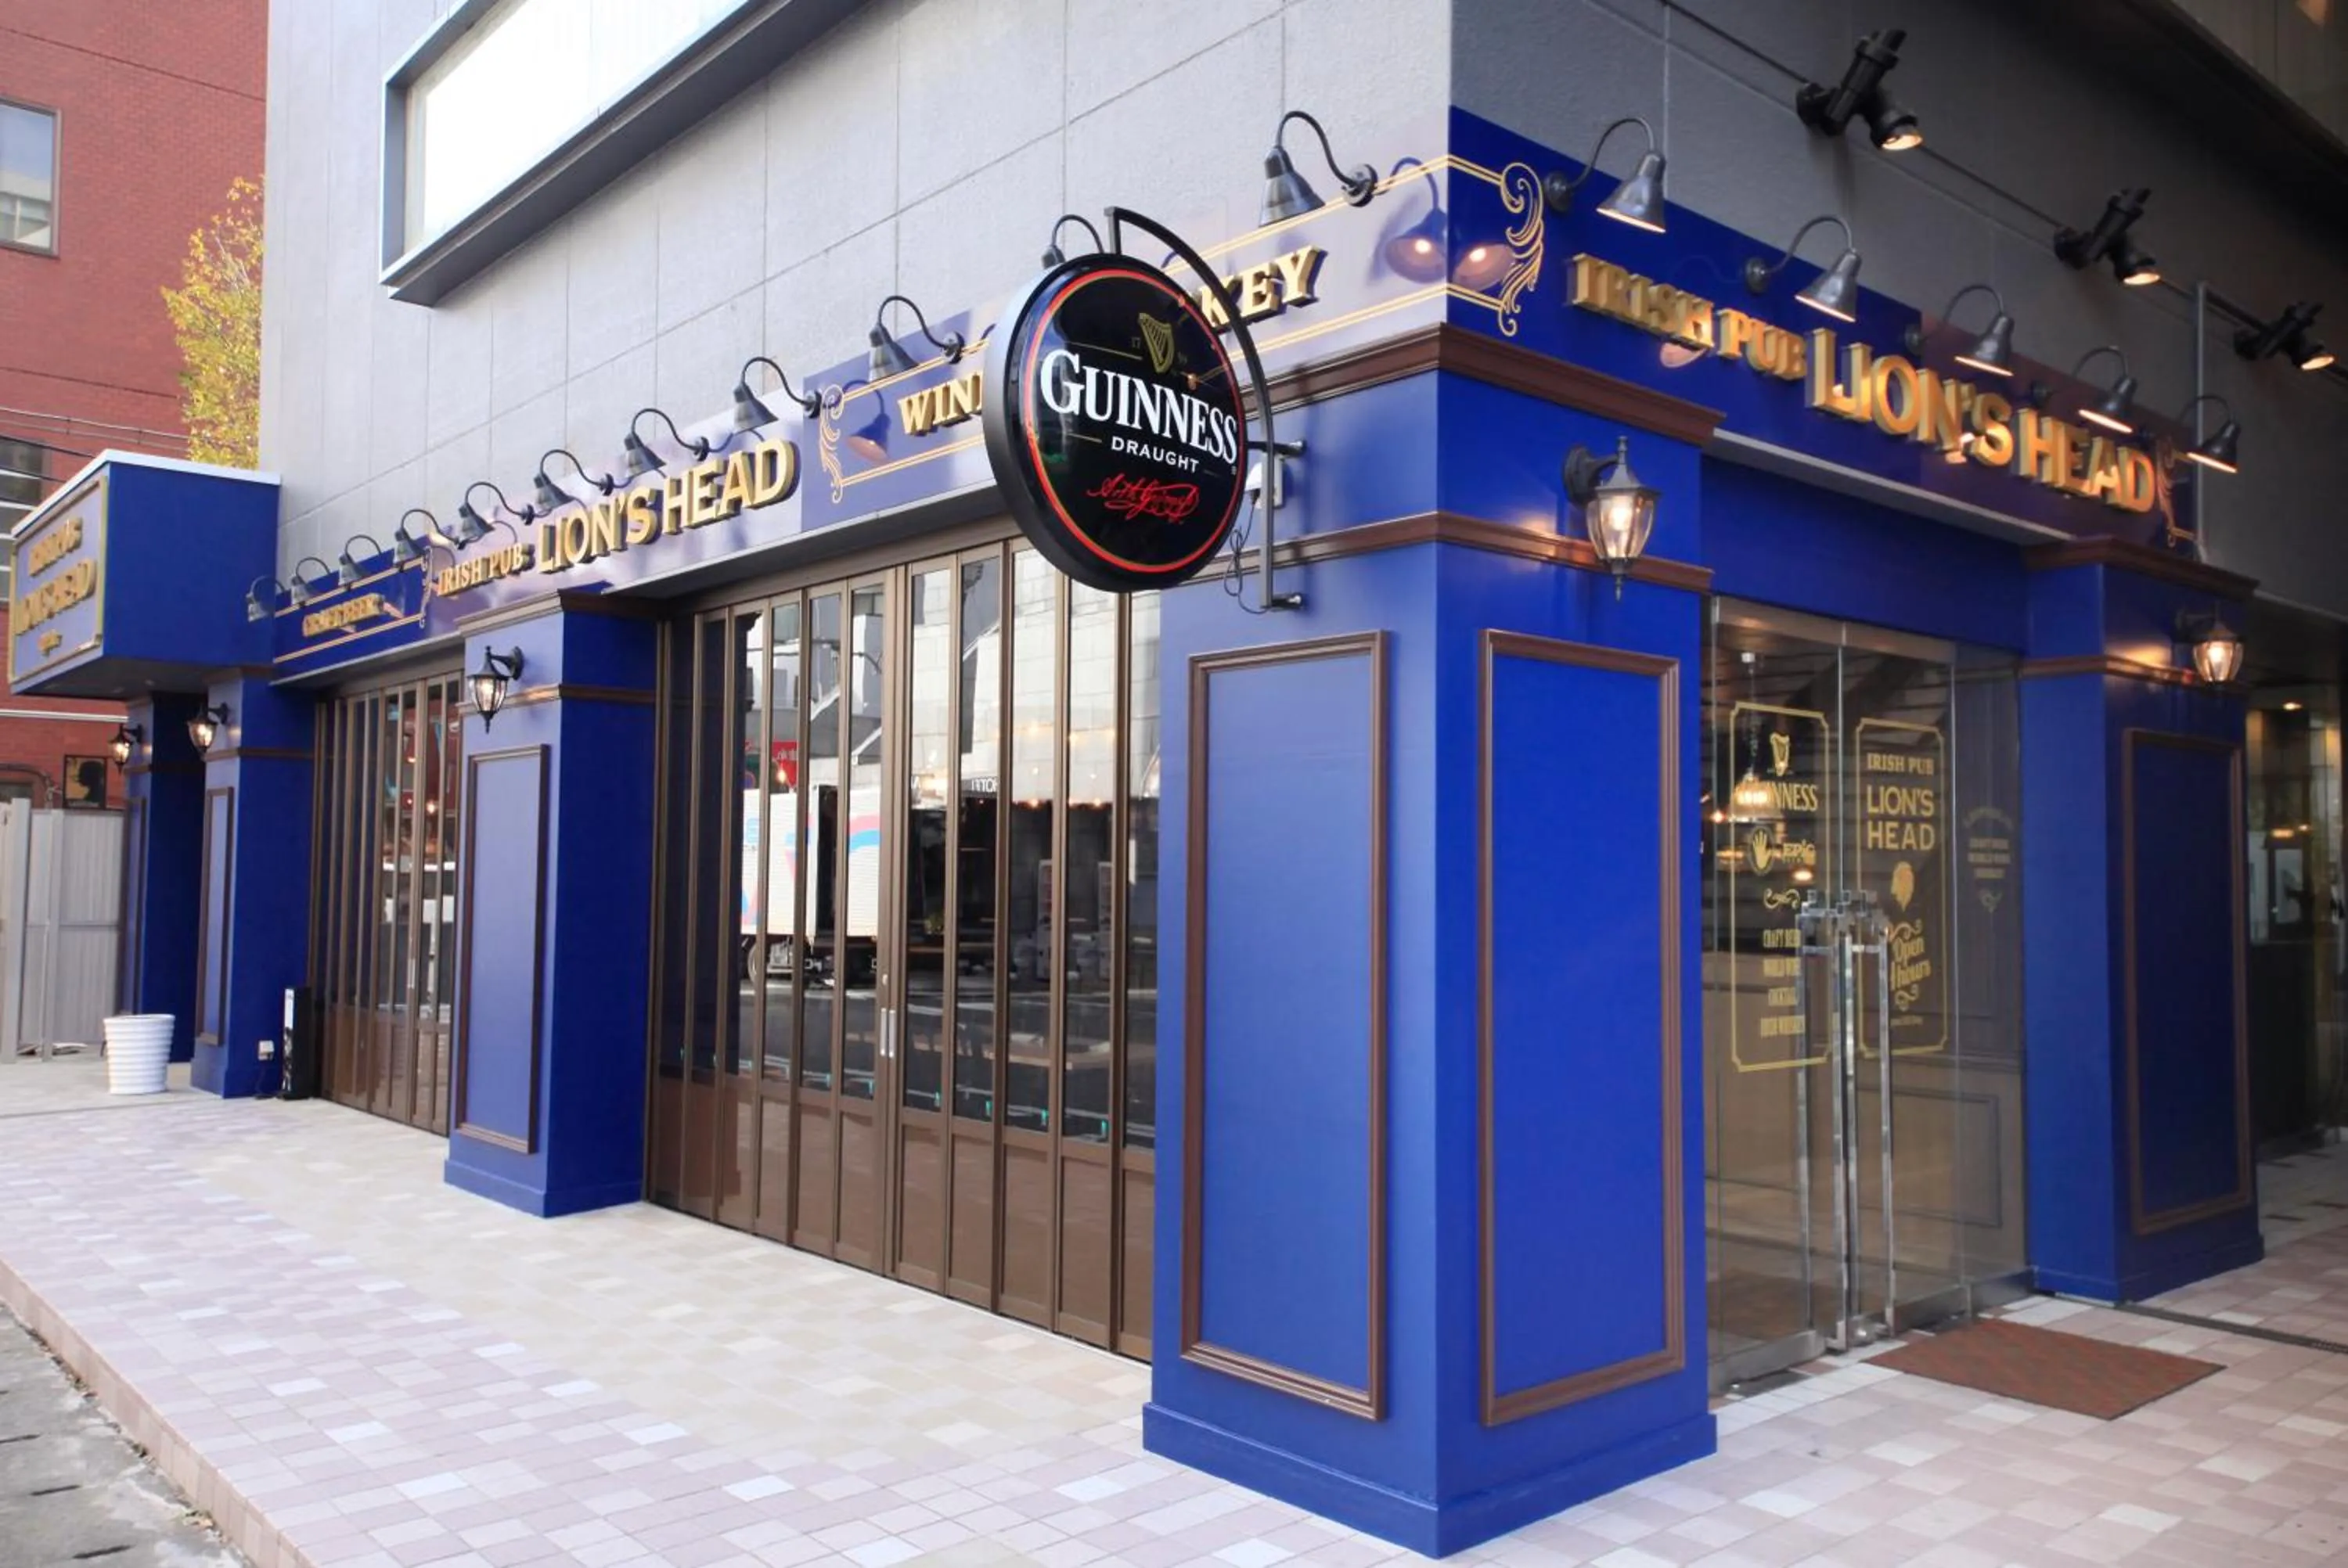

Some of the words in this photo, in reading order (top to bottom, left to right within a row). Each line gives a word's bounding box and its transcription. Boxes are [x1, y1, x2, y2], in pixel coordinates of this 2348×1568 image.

[1199, 245, 1323, 329] KEY
[897, 370, 983, 436] WIN
[1040, 349, 1238, 465] GUINNESS
[1572, 253, 1714, 347] IRISH
[1717, 308, 1807, 380] PUB
[1812, 328, 2013, 466] LION'S
[2018, 408, 2156, 513] HEAD
[1111, 436, 1200, 474] DRAUGHT
[438, 556, 487, 597] IRISH
[488, 542, 528, 578] PUB
[538, 486, 658, 573] LION'S
[664, 437, 797, 534] HEAD
[1867, 753, 1905, 772] IRISH
[1908, 757, 1934, 775] PUB
[1867, 784, 1934, 818] LION'S
[1867, 820, 1936, 851] HEAD
